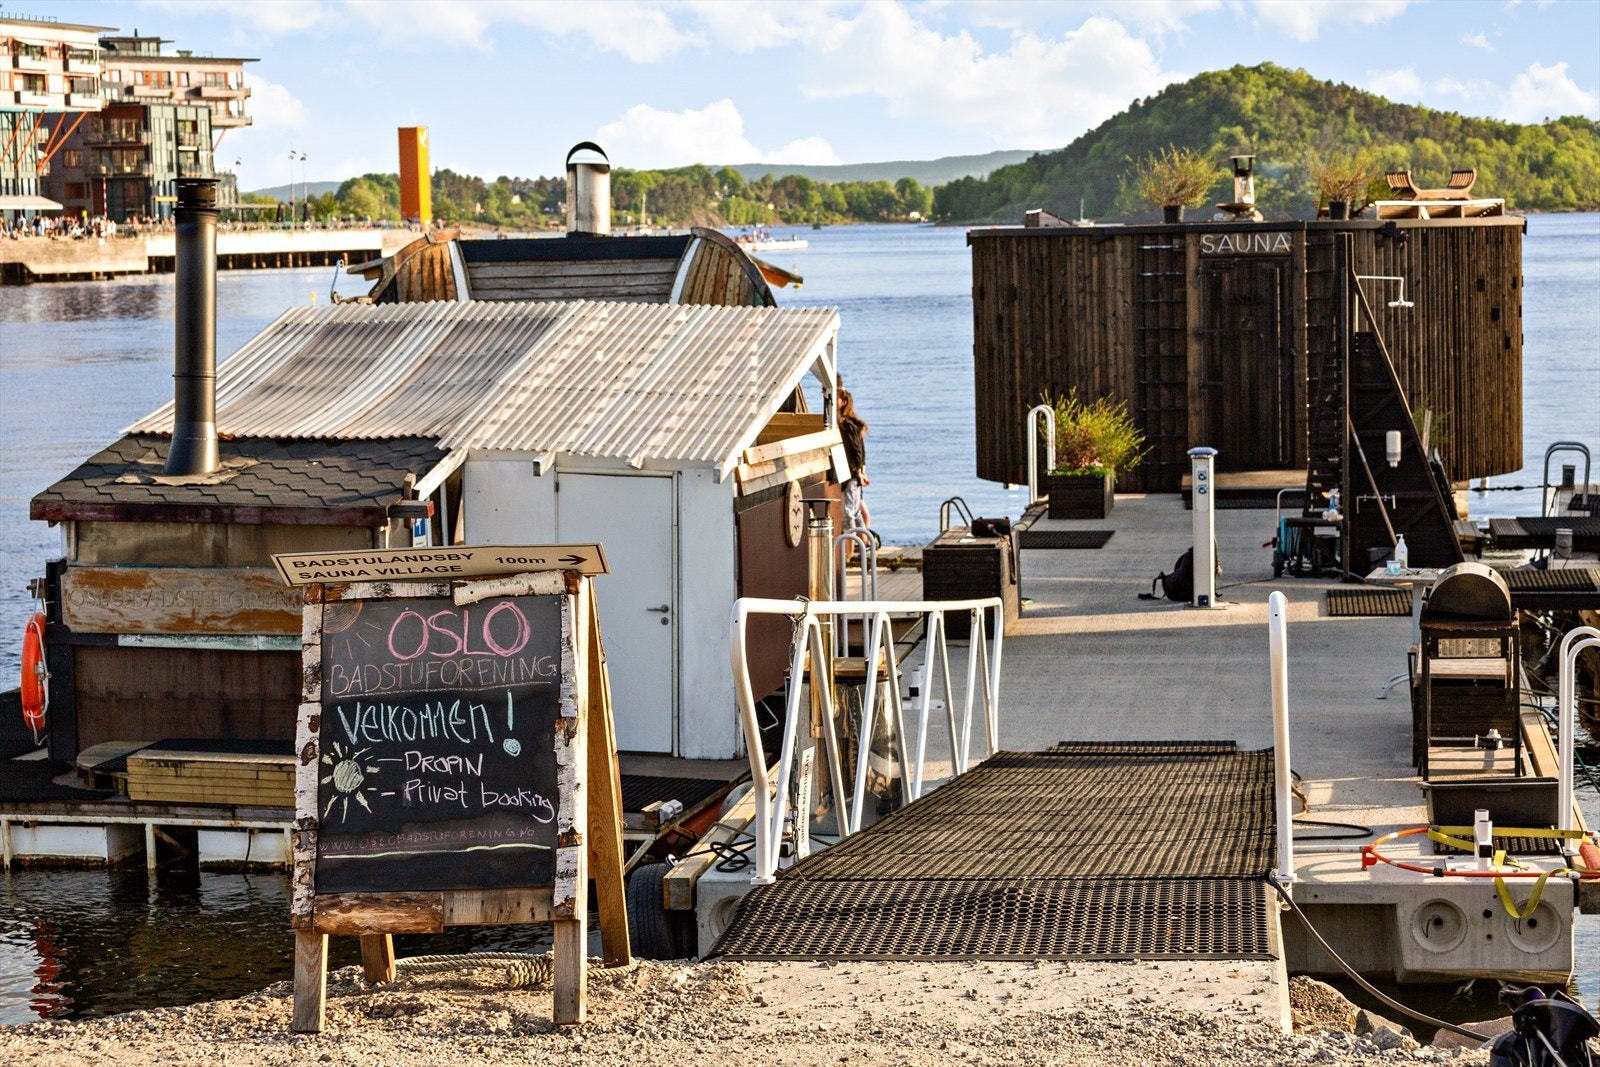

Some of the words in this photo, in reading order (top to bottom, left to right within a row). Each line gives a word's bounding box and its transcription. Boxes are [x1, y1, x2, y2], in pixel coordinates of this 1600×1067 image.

[1202, 233, 1290, 254] SAUNA
[292, 552, 474, 569] BADSTULANDSBY
[494, 555, 546, 566] 100m
[298, 567, 371, 580] SAUNA
[375, 565, 463, 576] VILLAGE
[387, 601, 531, 660] OSLO
[330, 655, 557, 695] BADSTUFORENING
[404, 779, 468, 808] Privat
[481, 782, 554, 822] booking
